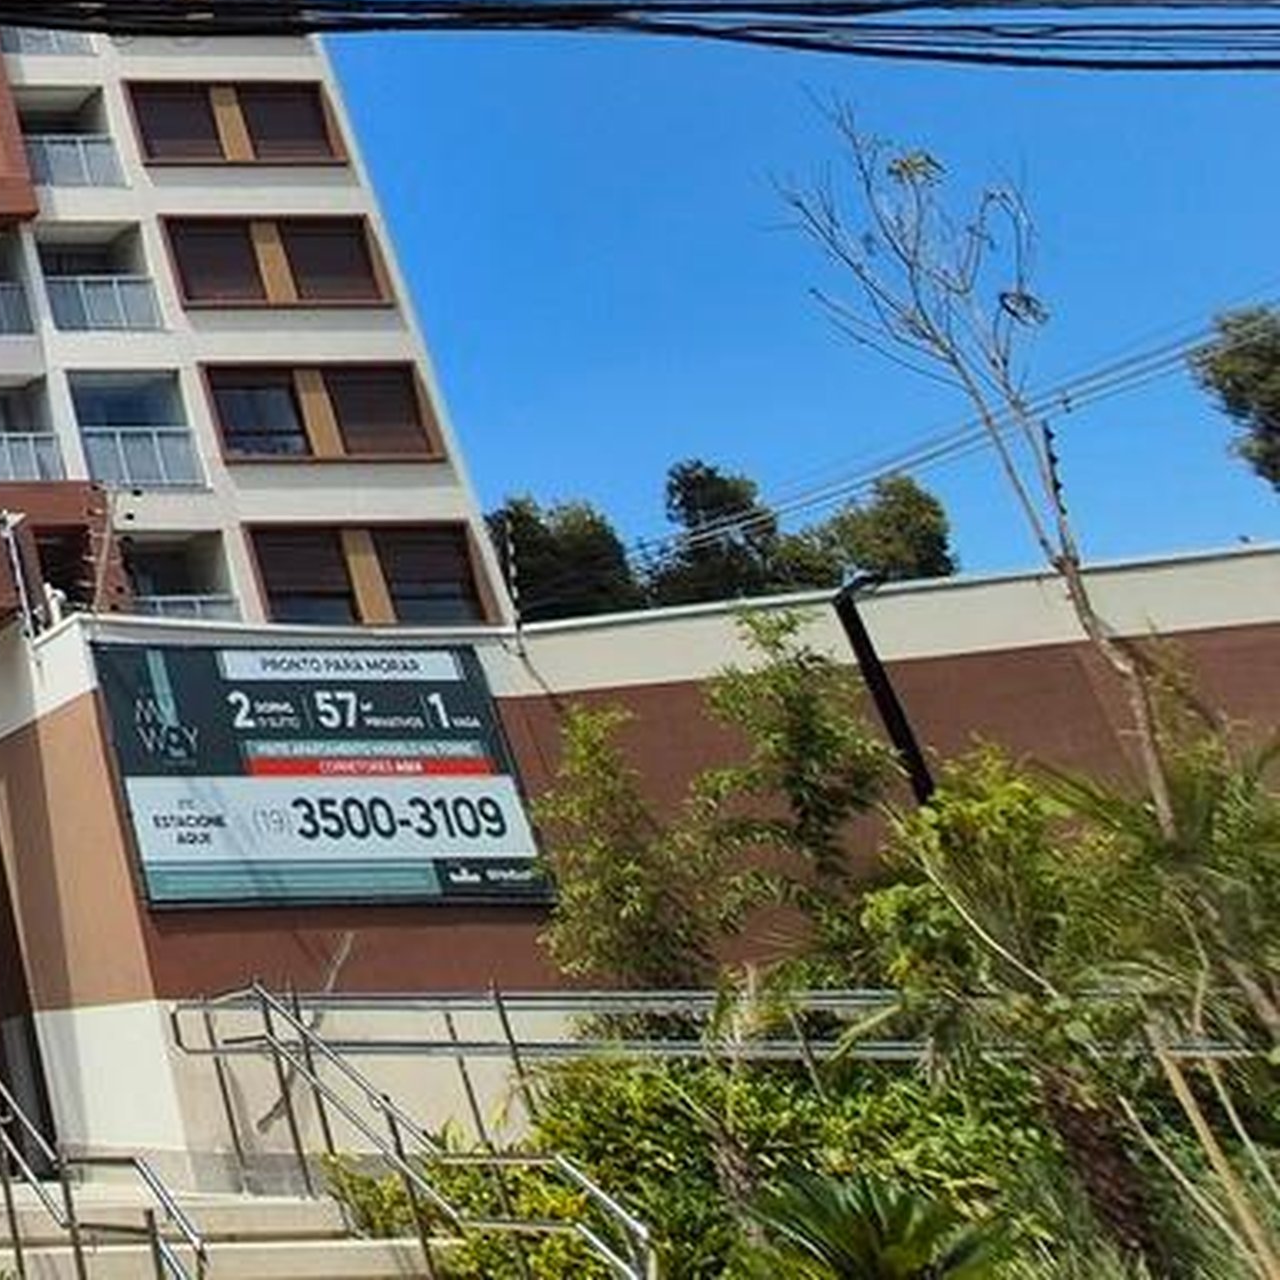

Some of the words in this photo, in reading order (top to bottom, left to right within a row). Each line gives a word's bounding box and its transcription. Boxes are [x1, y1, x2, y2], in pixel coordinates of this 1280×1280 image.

[260, 656, 321, 672] PRONTO
[324, 657, 364, 672] PARA
[366, 657, 421, 673] MORAR
[227, 691, 256, 728] 2
[314, 691, 358, 728] 57
[427, 692, 451, 728] 1
[152, 813, 228, 829] ESTACIONE
[291, 796, 508, 840] 3500-3109
